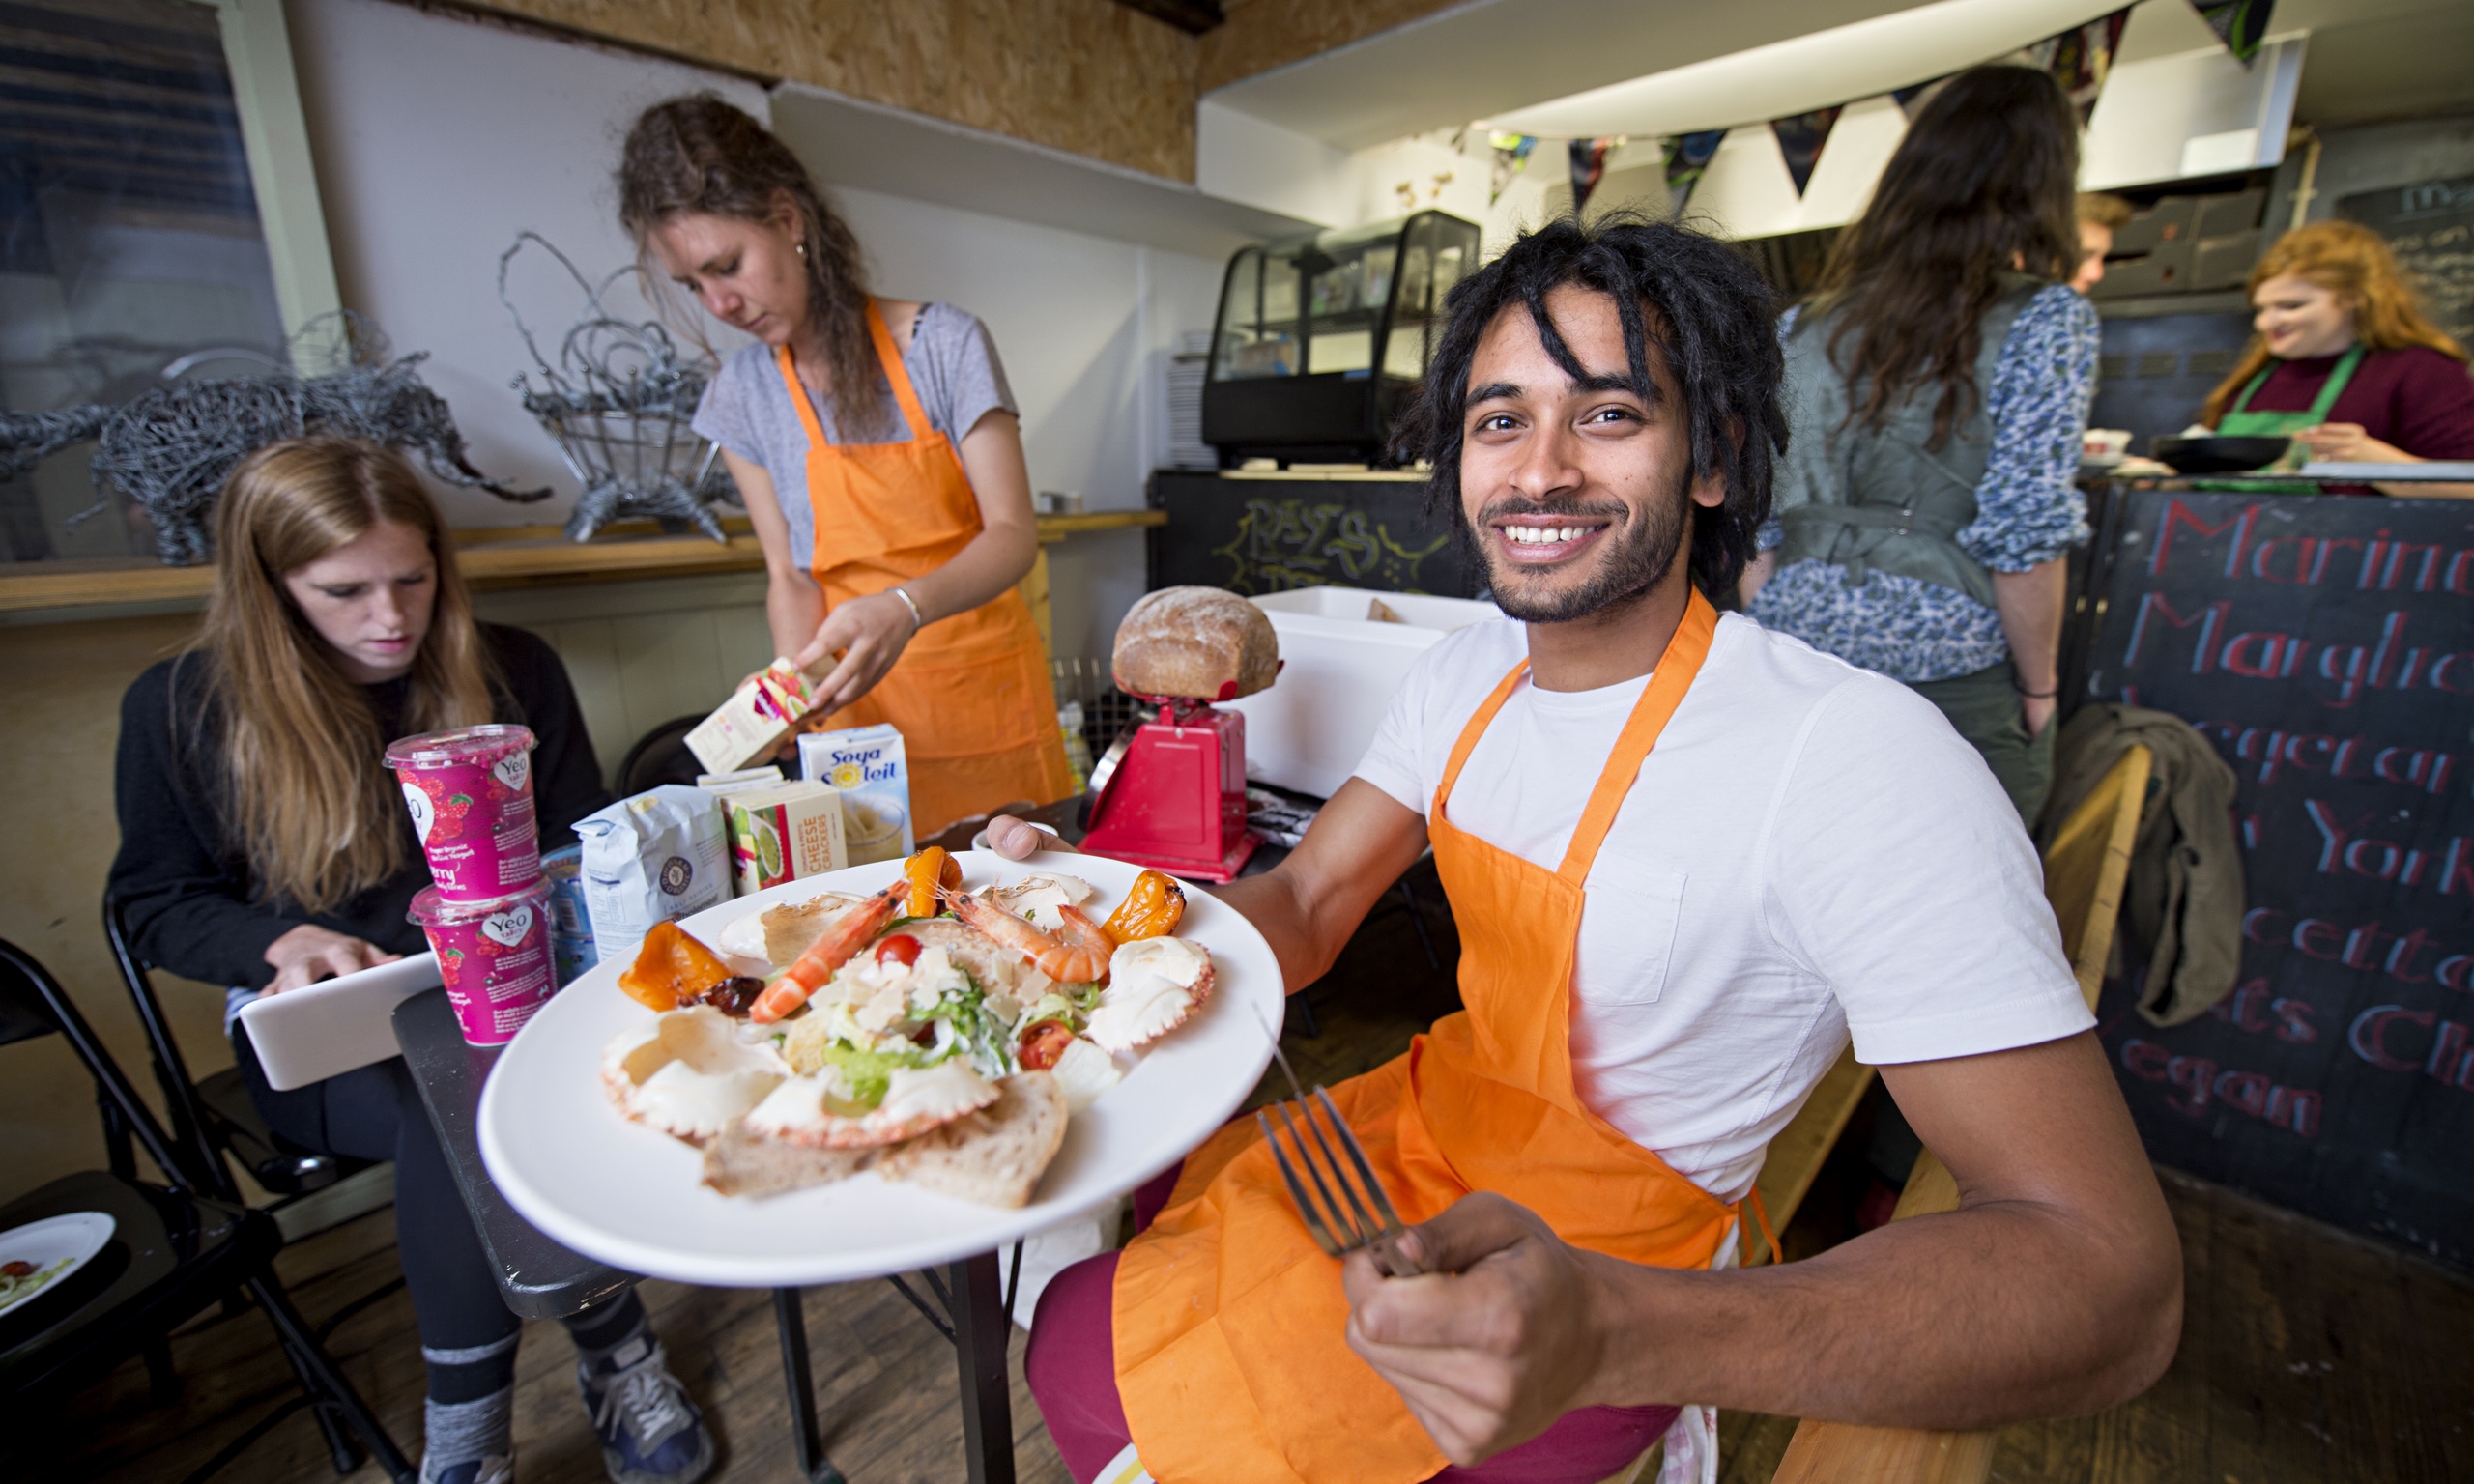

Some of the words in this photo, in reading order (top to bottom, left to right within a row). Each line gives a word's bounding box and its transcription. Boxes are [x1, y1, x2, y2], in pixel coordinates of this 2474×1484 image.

[501, 757, 528, 775] Yeo
[831, 749, 880, 766] Soya
[803, 816, 822, 874] CHEESE
[818, 813, 832, 870] CRACKERS
[491, 913, 527, 932] Yeo
[2101, 1011, 2323, 1138] egan
